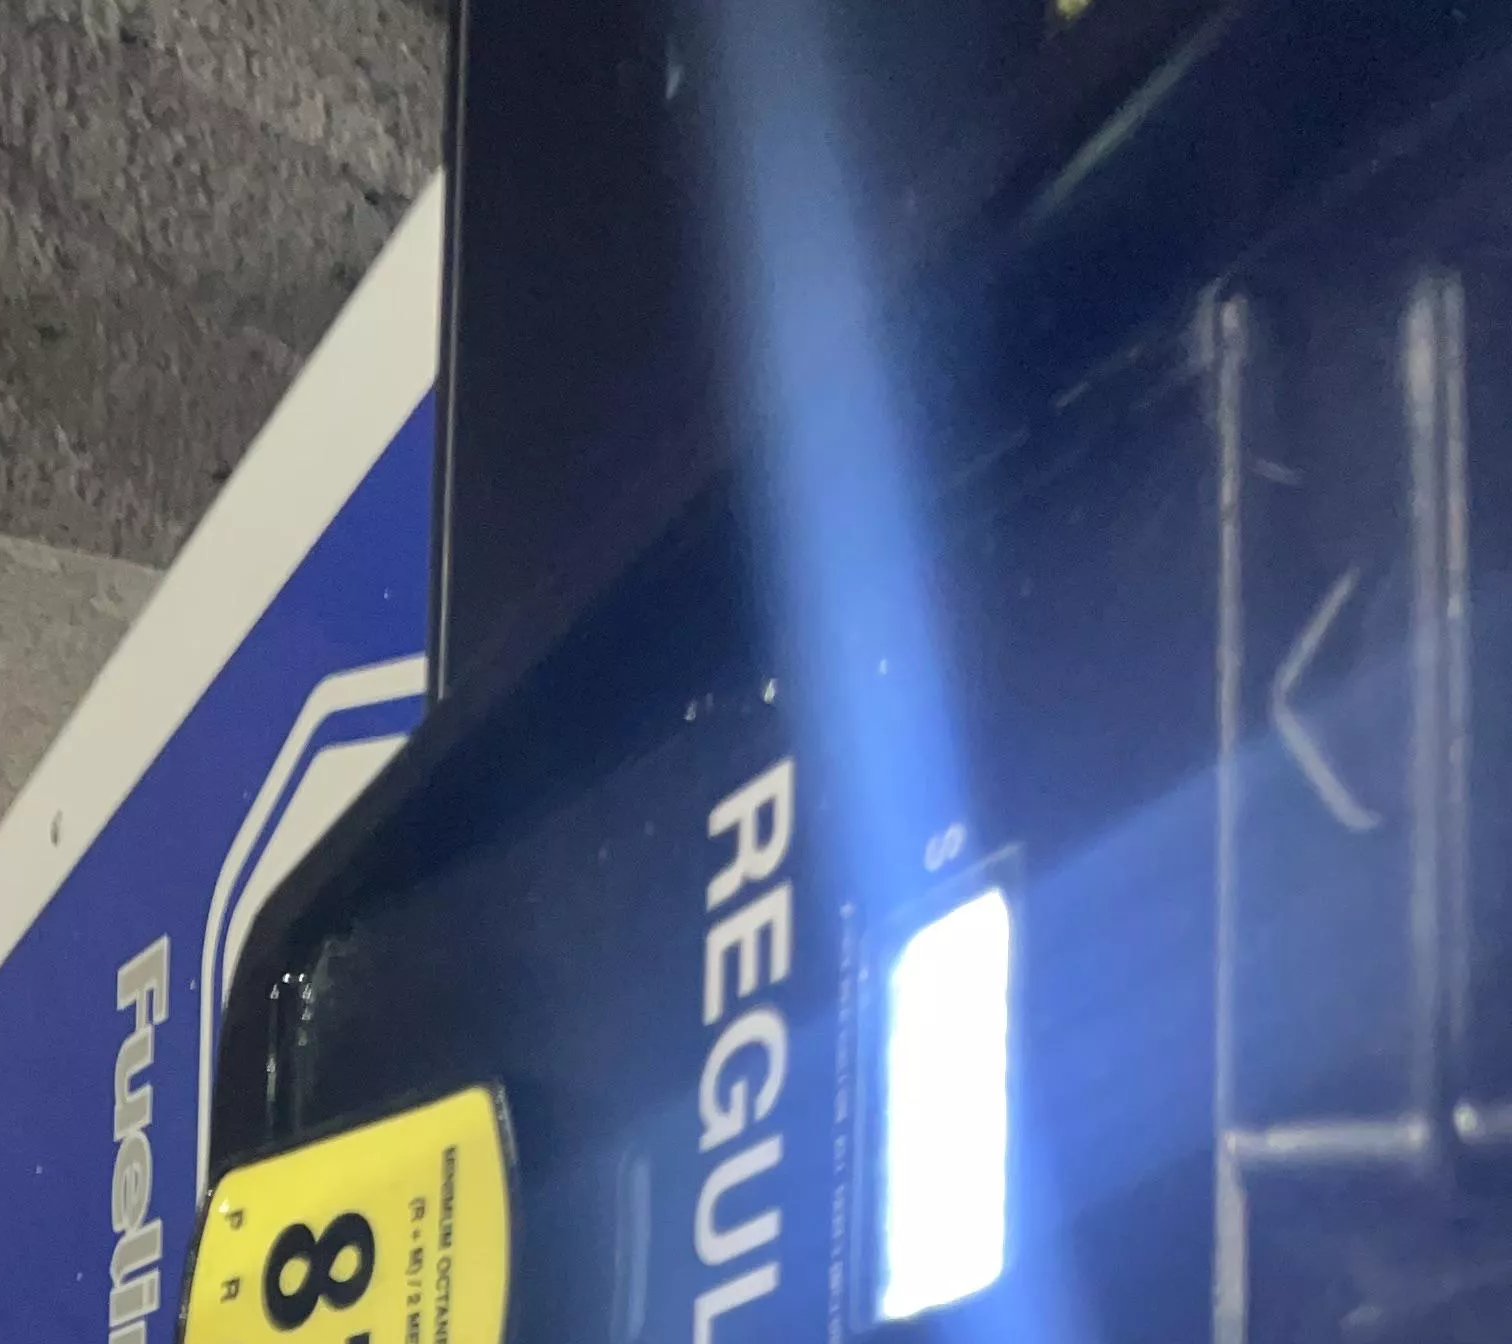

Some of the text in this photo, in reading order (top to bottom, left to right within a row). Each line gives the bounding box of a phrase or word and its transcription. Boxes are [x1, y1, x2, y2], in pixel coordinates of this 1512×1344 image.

[405, 1196, 427, 1224] (R
[435, 1146, 458, 1252] MINIMUM
[403, 1247, 425, 1276] M)
[406, 1293, 423, 1307] 2
